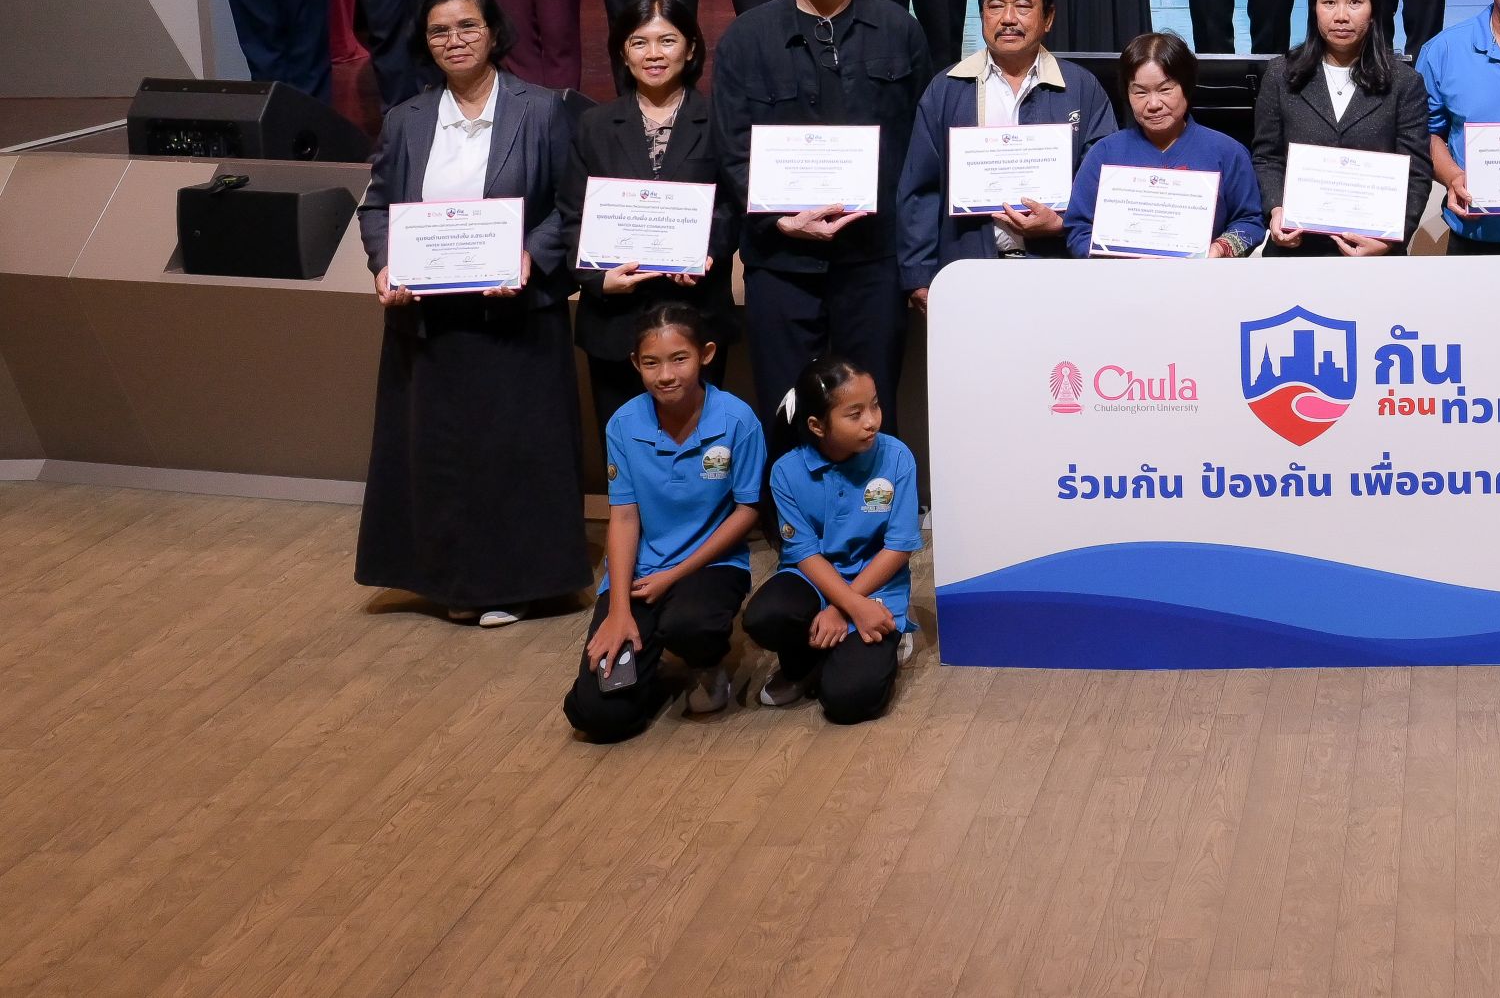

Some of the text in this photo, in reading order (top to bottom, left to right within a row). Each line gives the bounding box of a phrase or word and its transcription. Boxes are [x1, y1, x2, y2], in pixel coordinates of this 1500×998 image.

[1374, 324, 1463, 386] กัน
[1093, 362, 1199, 402] Chula
[1093, 402, 1199, 414] Chulalongkorn University
[1057, 463, 1183, 500] ร่วมกัน
[1201, 459, 1332, 499] ป้องกัน
